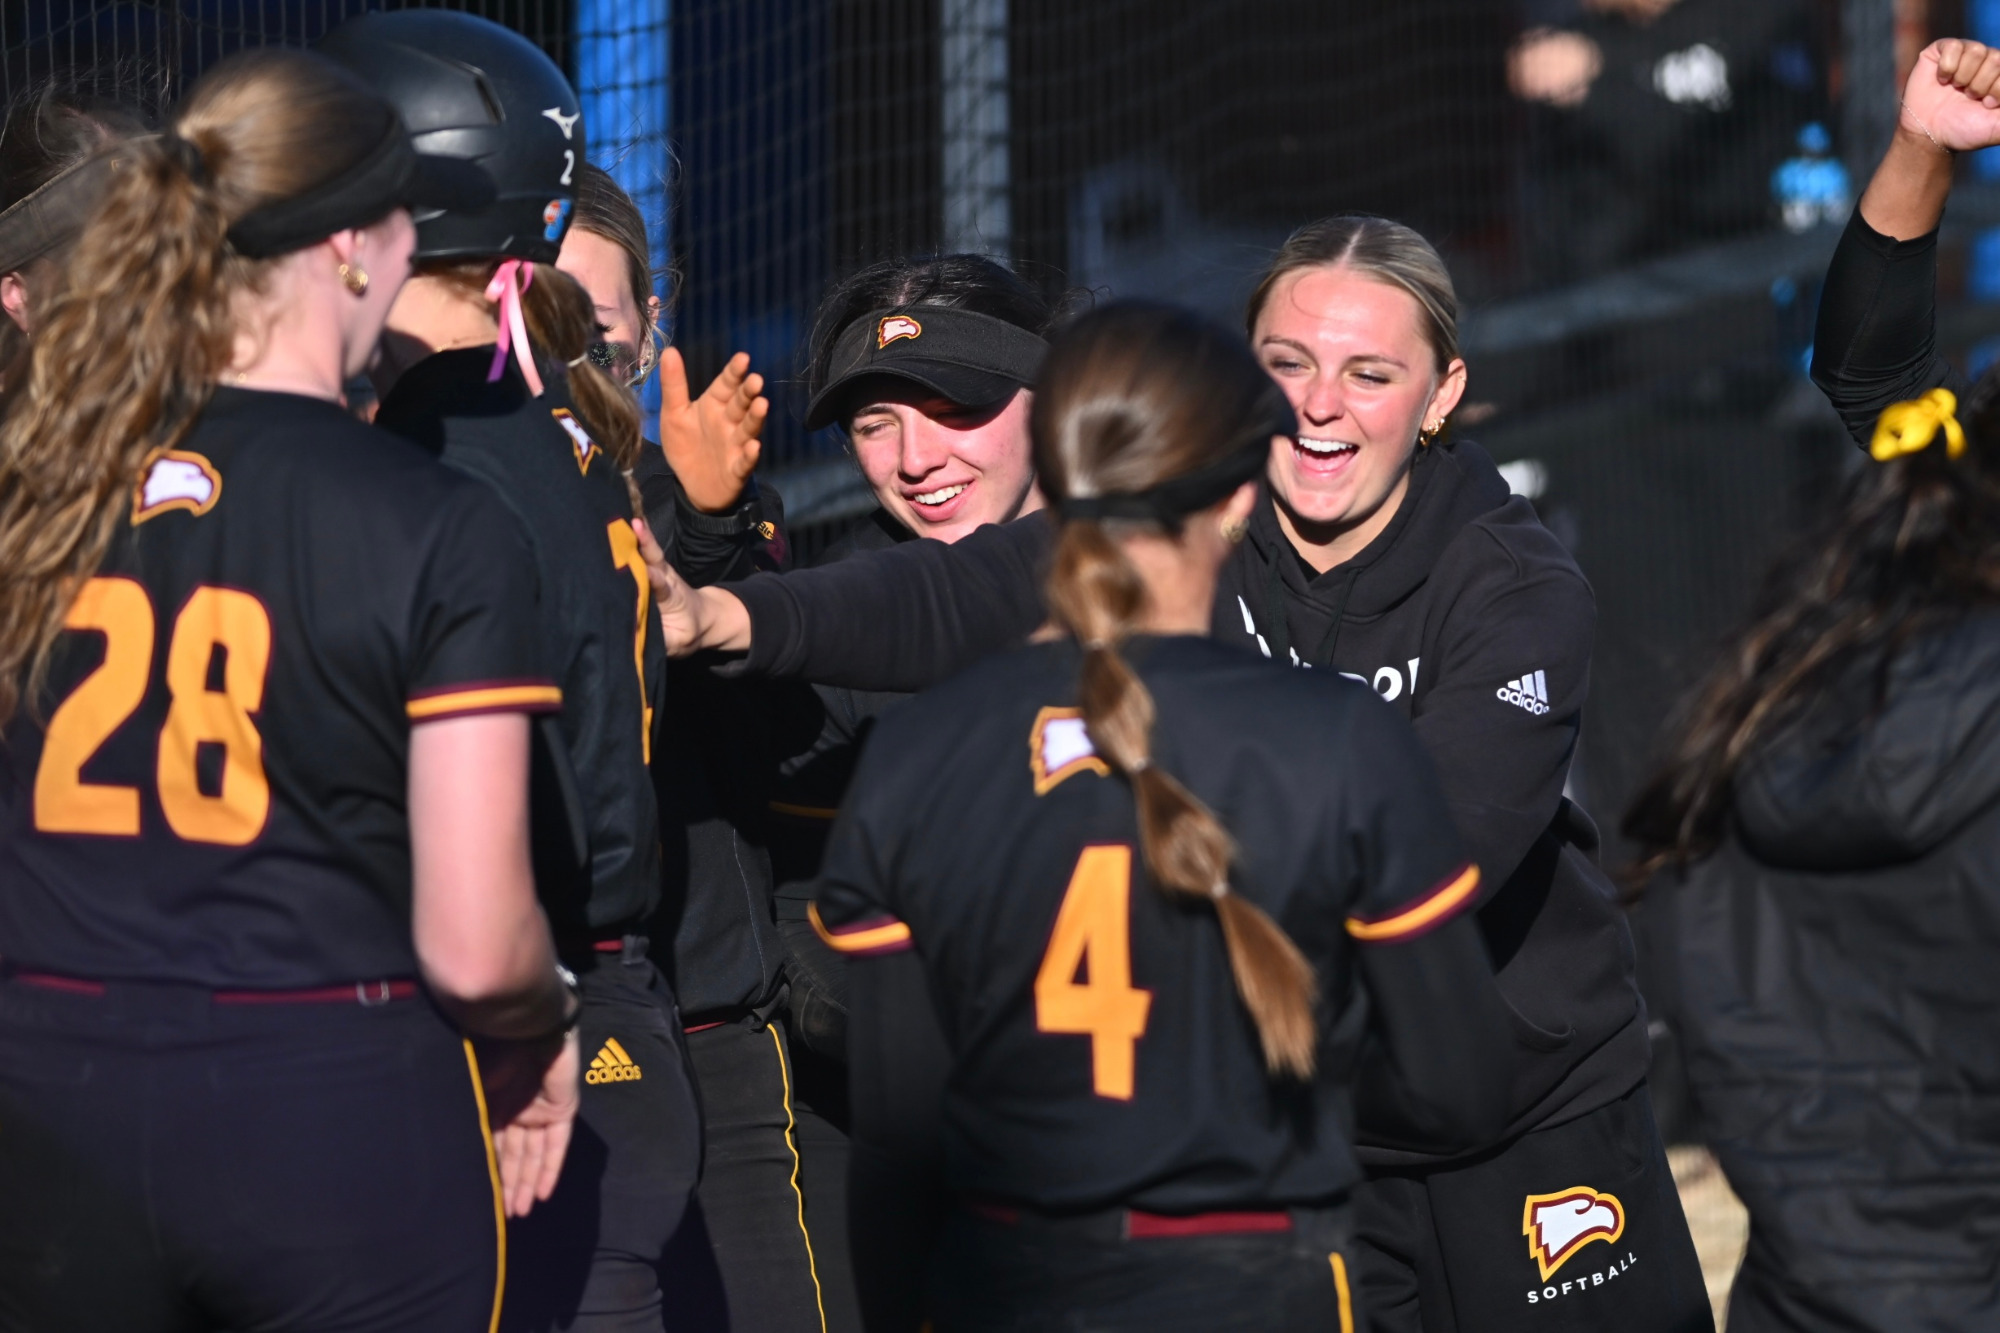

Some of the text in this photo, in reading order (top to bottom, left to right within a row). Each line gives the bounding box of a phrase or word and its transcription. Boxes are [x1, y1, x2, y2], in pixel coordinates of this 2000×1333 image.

[560, 149, 575, 186] 2
[33, 575, 271, 847] 28
[1033, 844, 1153, 1101] 4
[585, 1064, 642, 1085] adidas
[1526, 1251, 1638, 1304] SOFTBALL
